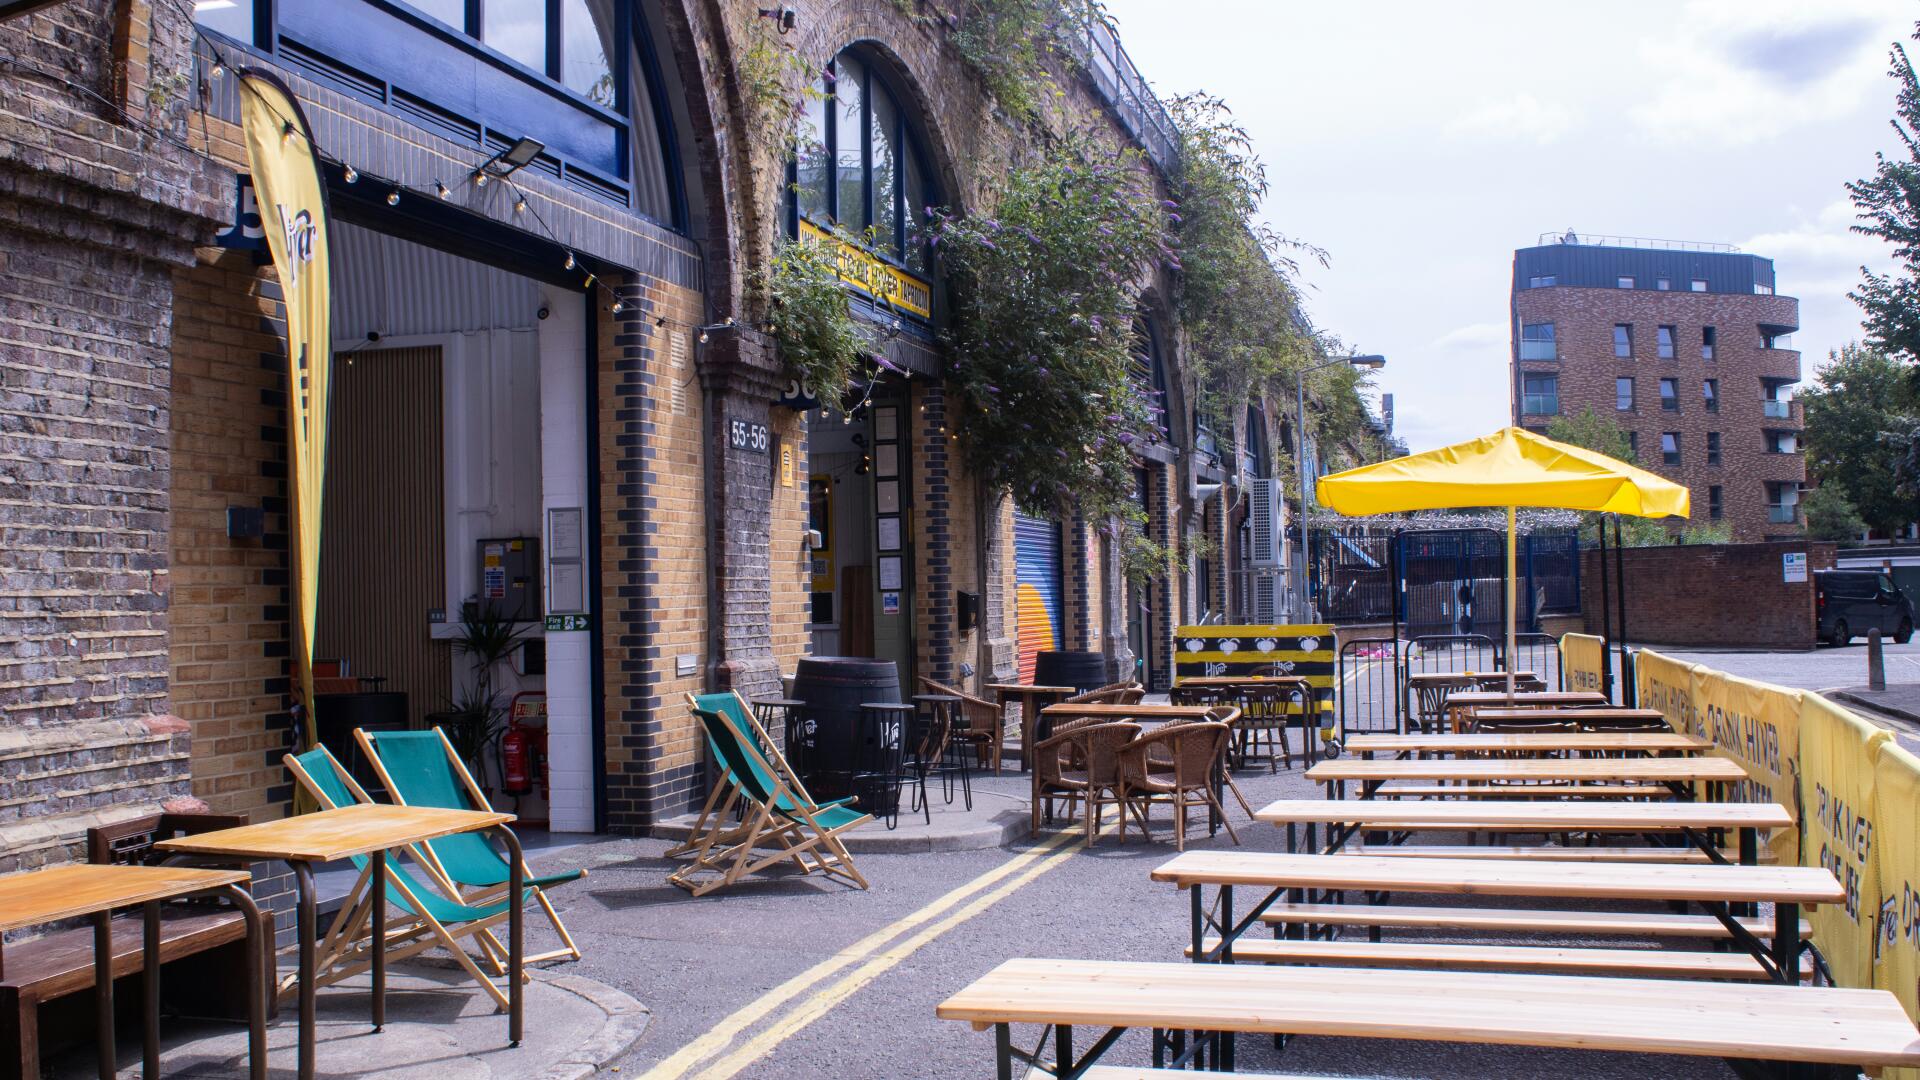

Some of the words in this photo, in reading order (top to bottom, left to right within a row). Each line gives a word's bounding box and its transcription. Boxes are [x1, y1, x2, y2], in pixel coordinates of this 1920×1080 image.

[1205, 661, 1228, 679] Hiver
[1708, 703, 1745, 760] DRINK
[1745, 715, 1781, 778] HIVER
